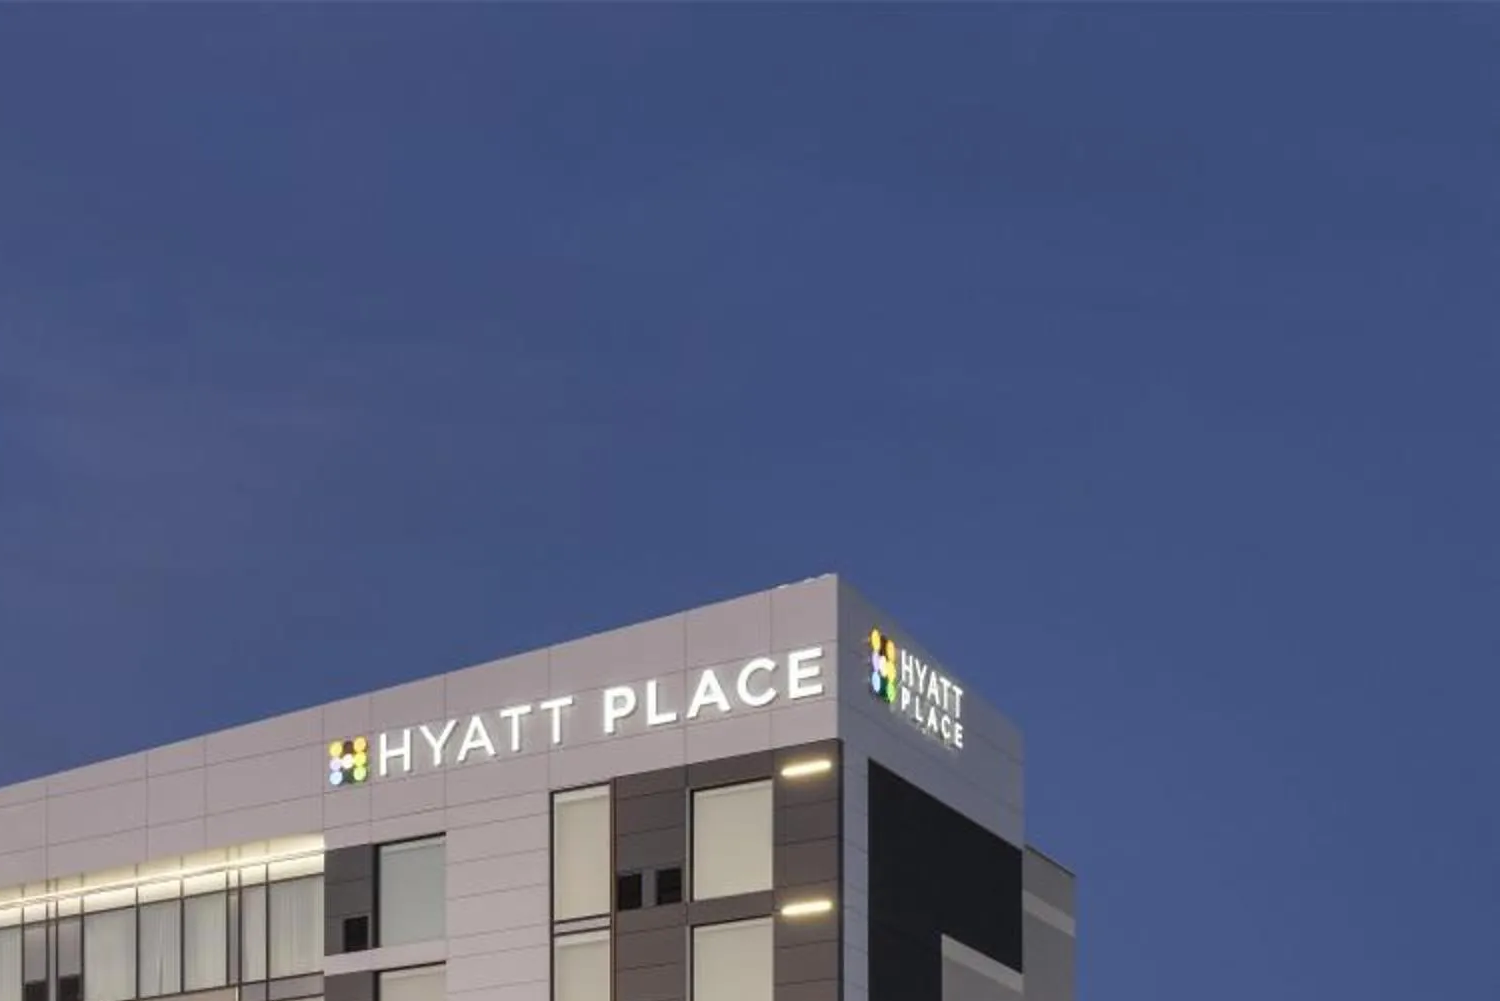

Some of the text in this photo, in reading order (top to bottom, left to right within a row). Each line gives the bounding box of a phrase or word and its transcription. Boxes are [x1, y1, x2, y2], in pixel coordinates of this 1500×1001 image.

[378, 646, 825, 777] HYATT PLACE
[901, 649, 963, 719] HYATT
[901, 686, 963, 749] PLACE
